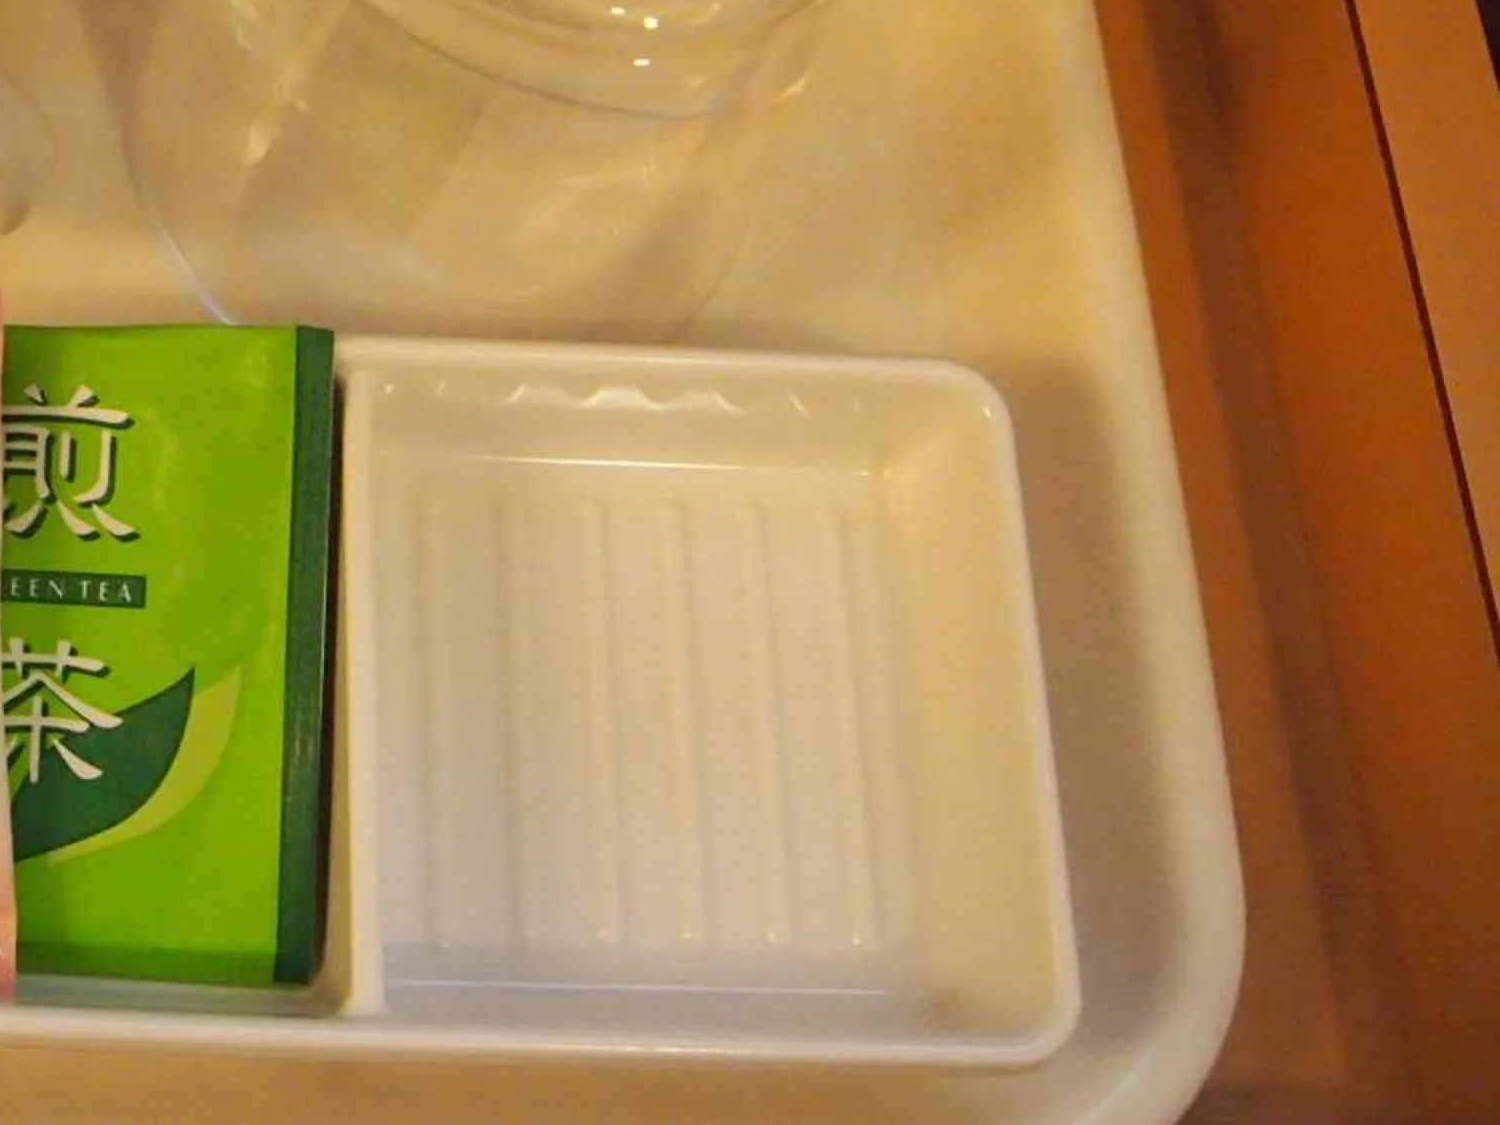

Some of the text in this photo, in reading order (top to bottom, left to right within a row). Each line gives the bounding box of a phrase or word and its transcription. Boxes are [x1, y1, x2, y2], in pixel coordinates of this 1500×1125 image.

[1, 384, 137, 535] 煎
[10, 576, 132, 603] EEN TEA
[1, 637, 124, 783] 茶
